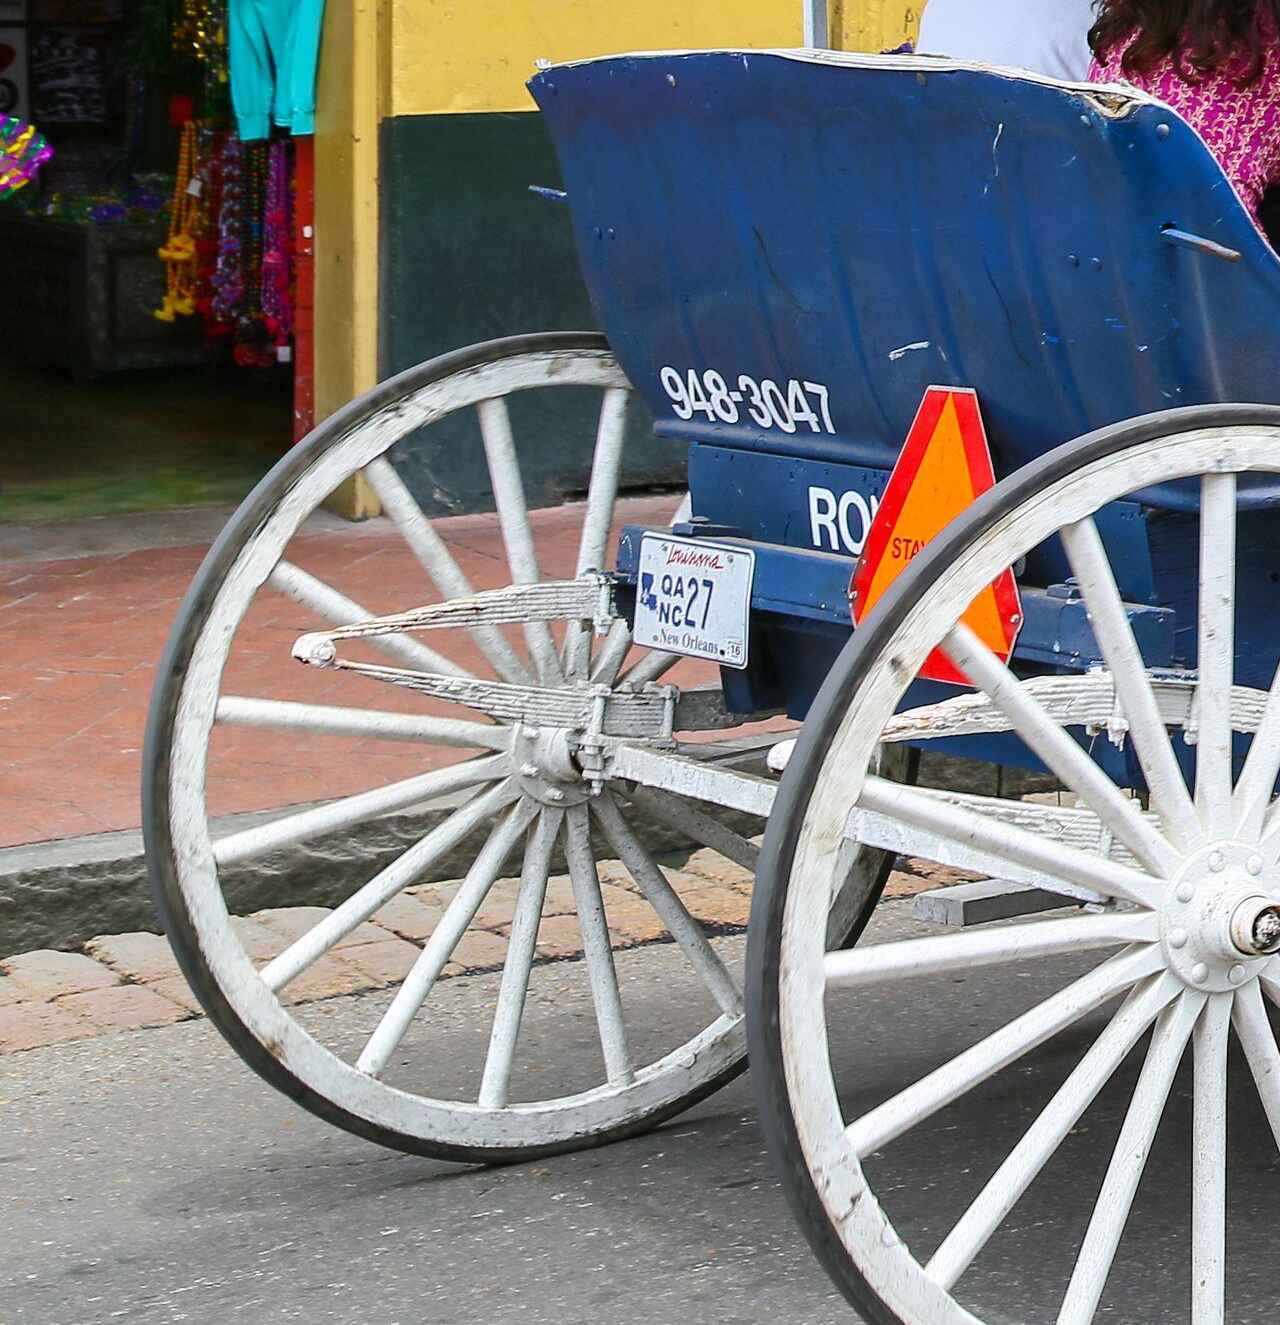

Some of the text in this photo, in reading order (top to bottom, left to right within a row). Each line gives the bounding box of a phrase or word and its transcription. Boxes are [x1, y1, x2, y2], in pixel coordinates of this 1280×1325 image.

[659, 366, 837, 435] 948-3047
[807, 485, 880, 556] RO
[661, 574, 685, 598] QA
[684, 577, 714, 630] 27
[658, 602, 683, 627] NC
[660, 628, 680, 646] New
[681, 632, 719, 655] Orleans
